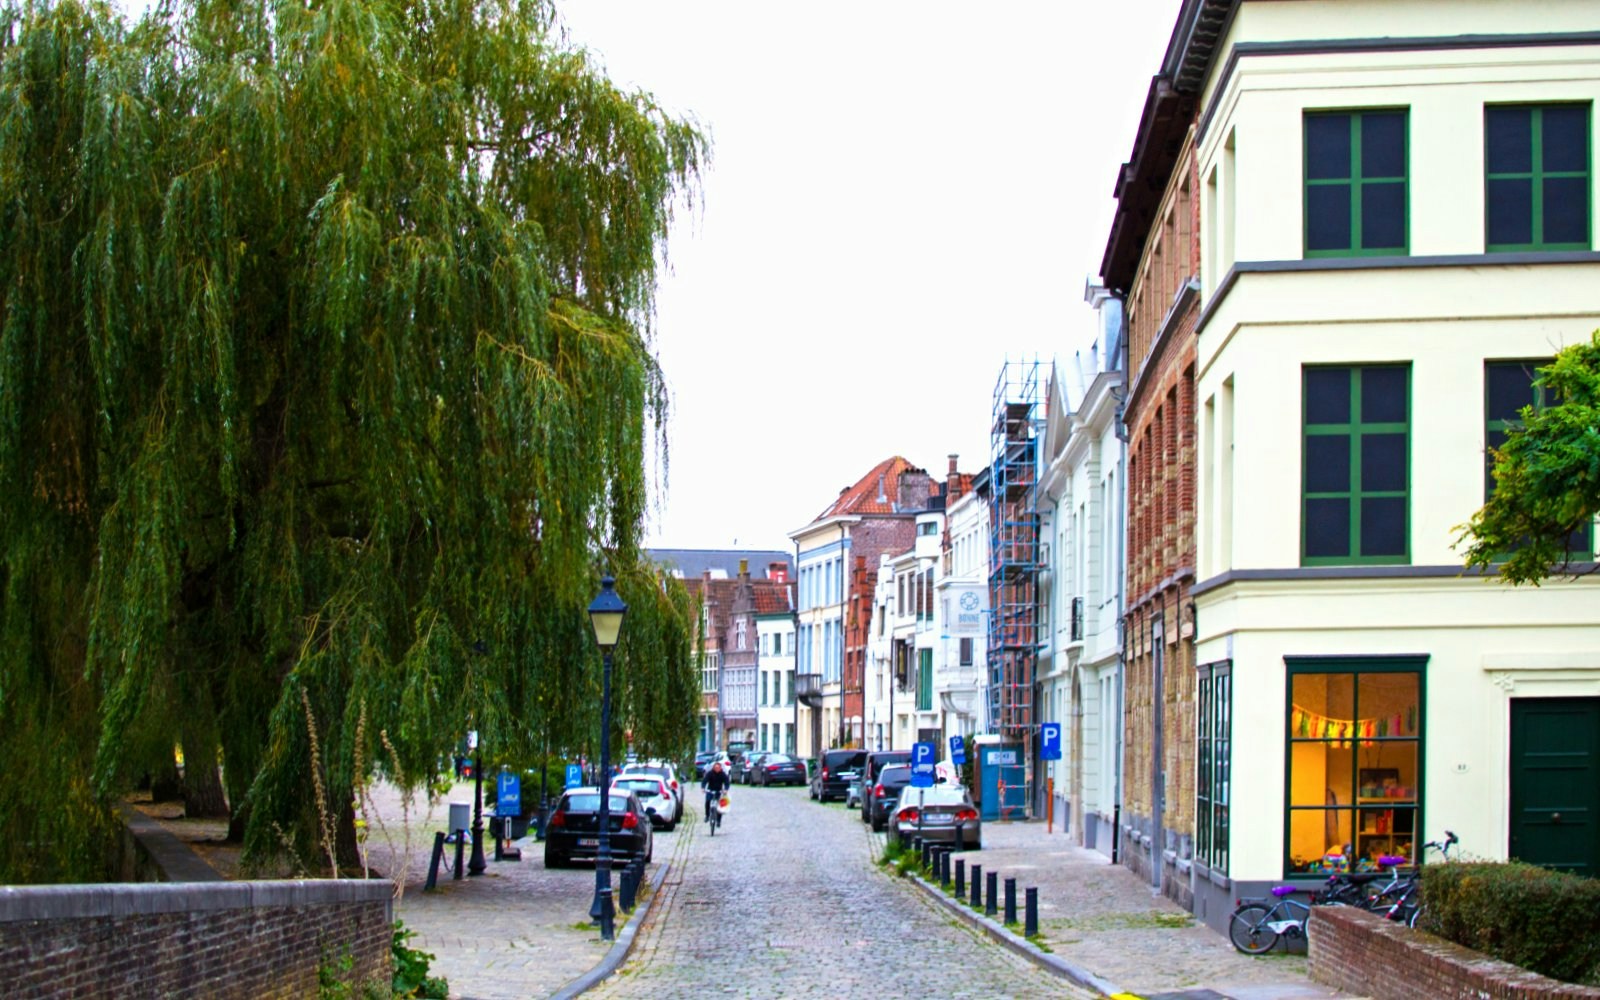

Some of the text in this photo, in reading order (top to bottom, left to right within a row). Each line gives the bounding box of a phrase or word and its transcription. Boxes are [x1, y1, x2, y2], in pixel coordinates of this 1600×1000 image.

[953, 738, 960, 749] P
[1044, 727, 1058, 747] P
[917, 745, 930, 763] P
[570, 766, 578, 779] P
[503, 776, 515, 792] P
